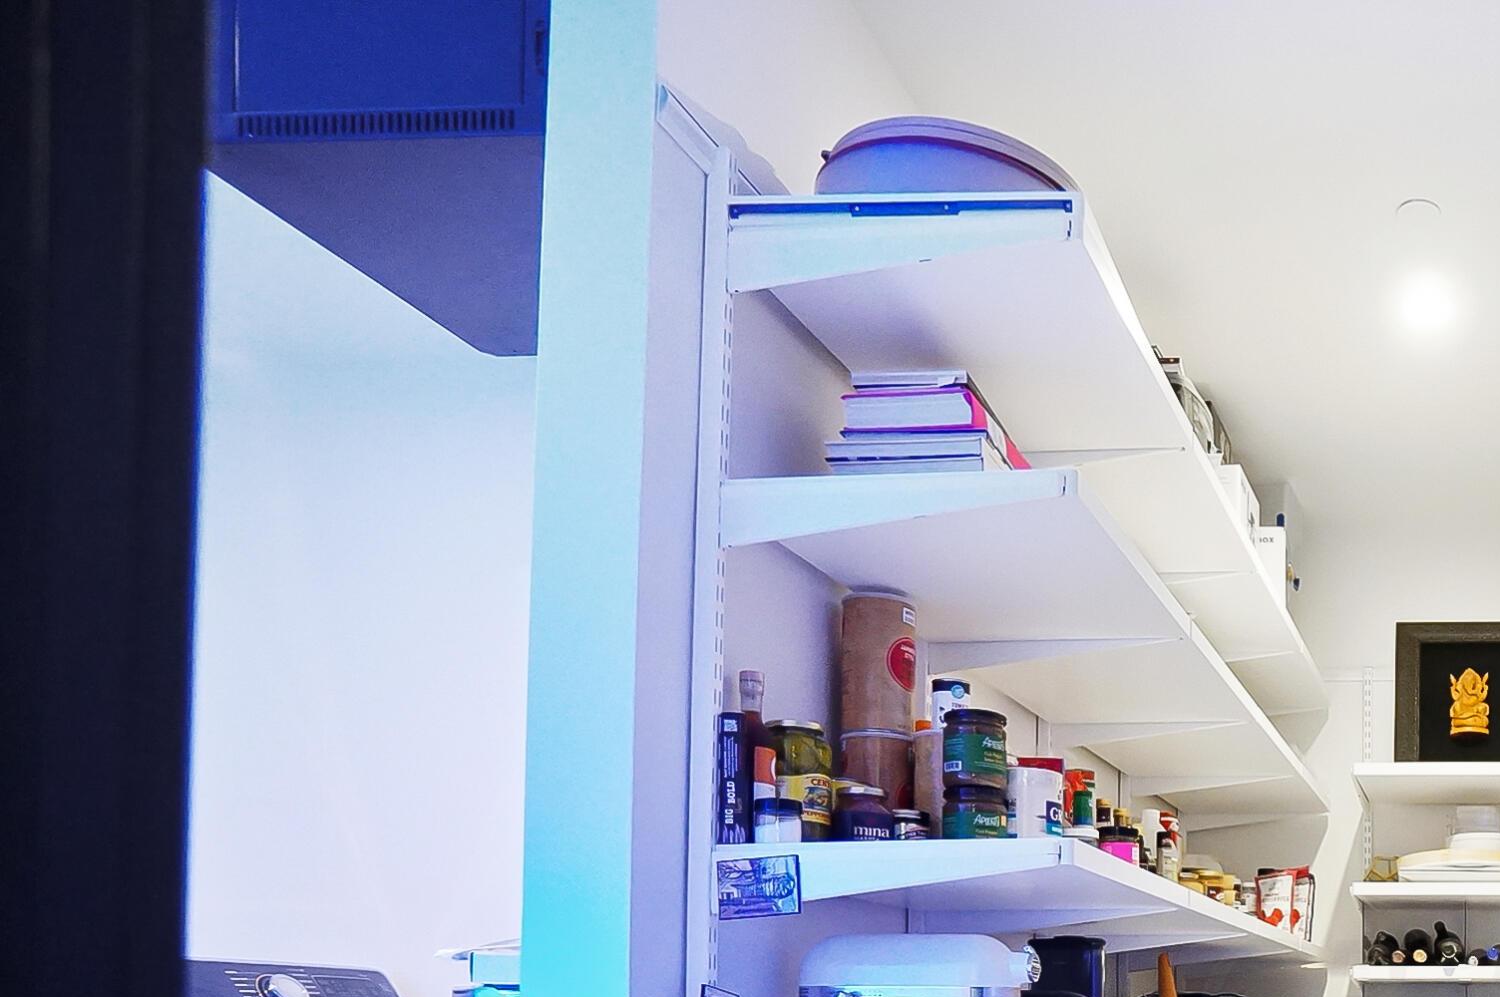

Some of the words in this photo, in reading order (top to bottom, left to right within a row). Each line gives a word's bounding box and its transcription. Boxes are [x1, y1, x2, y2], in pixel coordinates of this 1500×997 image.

[726, 780, 736, 804] BOLD
[725, 808, 734, 824] BIG
[854, 826, 890, 838] mina
